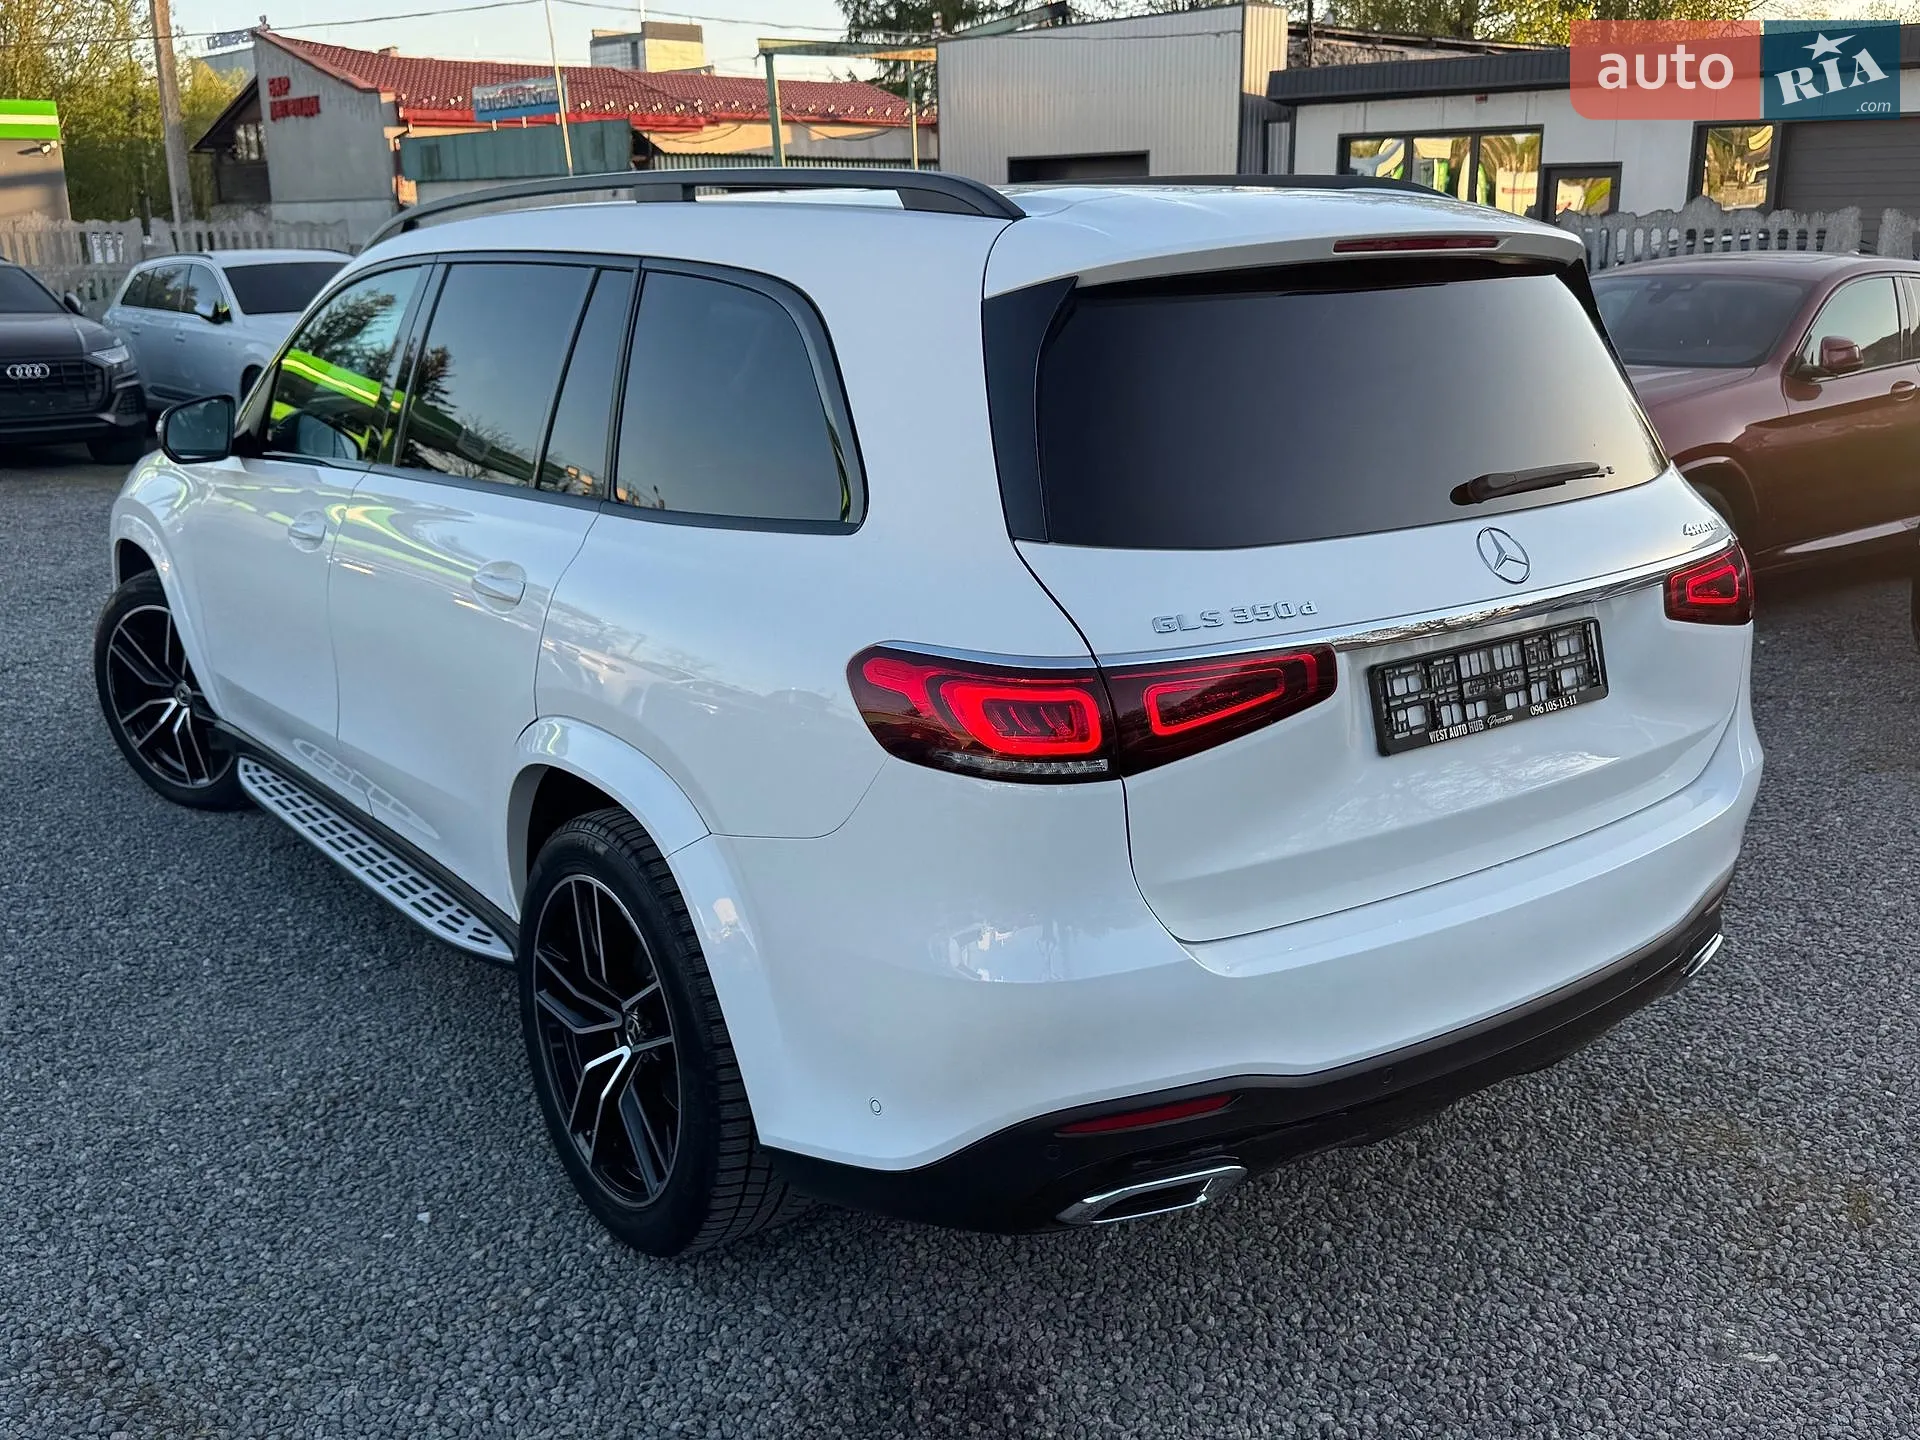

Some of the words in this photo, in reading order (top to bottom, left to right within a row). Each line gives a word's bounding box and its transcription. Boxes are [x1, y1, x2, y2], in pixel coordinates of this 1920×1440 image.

[1151, 609, 1224, 634] GLS
[1428, 728, 1449, 744] WEST
[1449, 723, 1468, 739] AUTO
[1467, 719, 1485, 733] HUB
[1530, 703, 1544, 716] 096
[1545, 694, 1577, 713] 105-11-11
